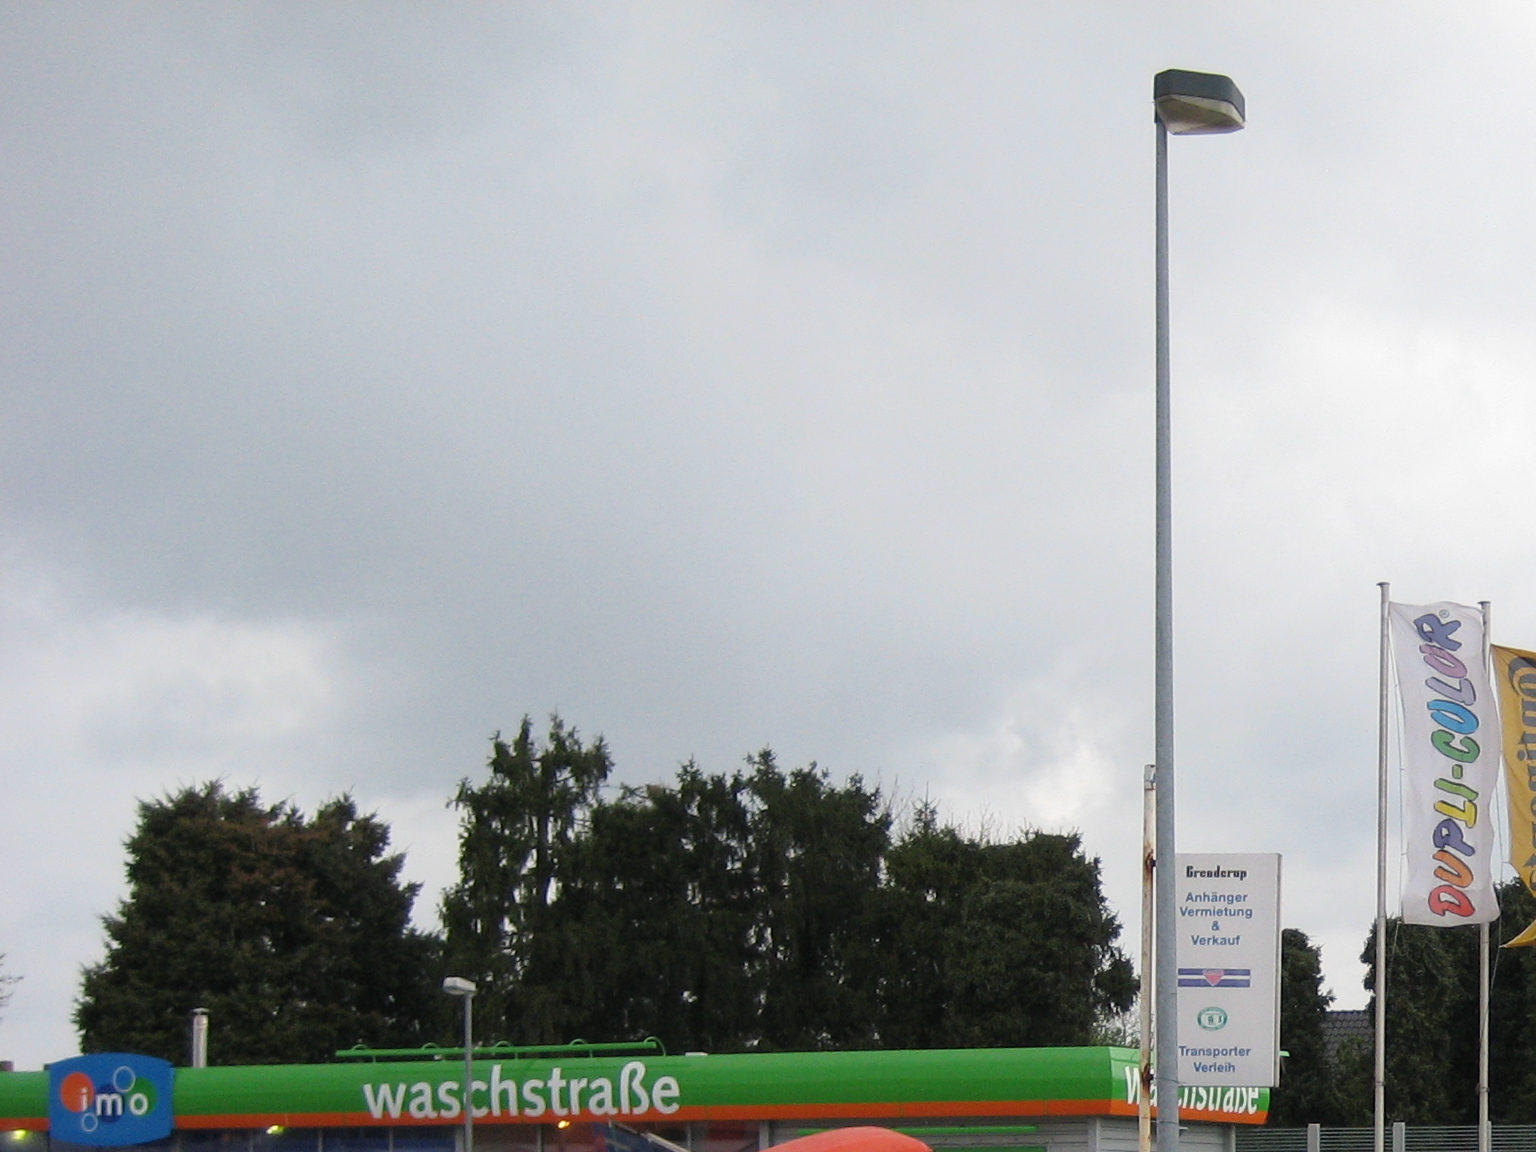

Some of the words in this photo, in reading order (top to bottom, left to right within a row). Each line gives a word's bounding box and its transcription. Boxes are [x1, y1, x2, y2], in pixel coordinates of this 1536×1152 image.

[1185, 891, 1248, 905] Anhänger
[1179, 906, 1253, 919] Vermietung
[1211, 920, 1220, 931] &
[1191, 934, 1241, 946] Verkauf
[1179, 1045, 1251, 1058] Transporter
[1193, 1062, 1236, 1072] Verleih
[363, 1061, 681, 1119] waschstraße
[81, 1086, 149, 1116] imo
